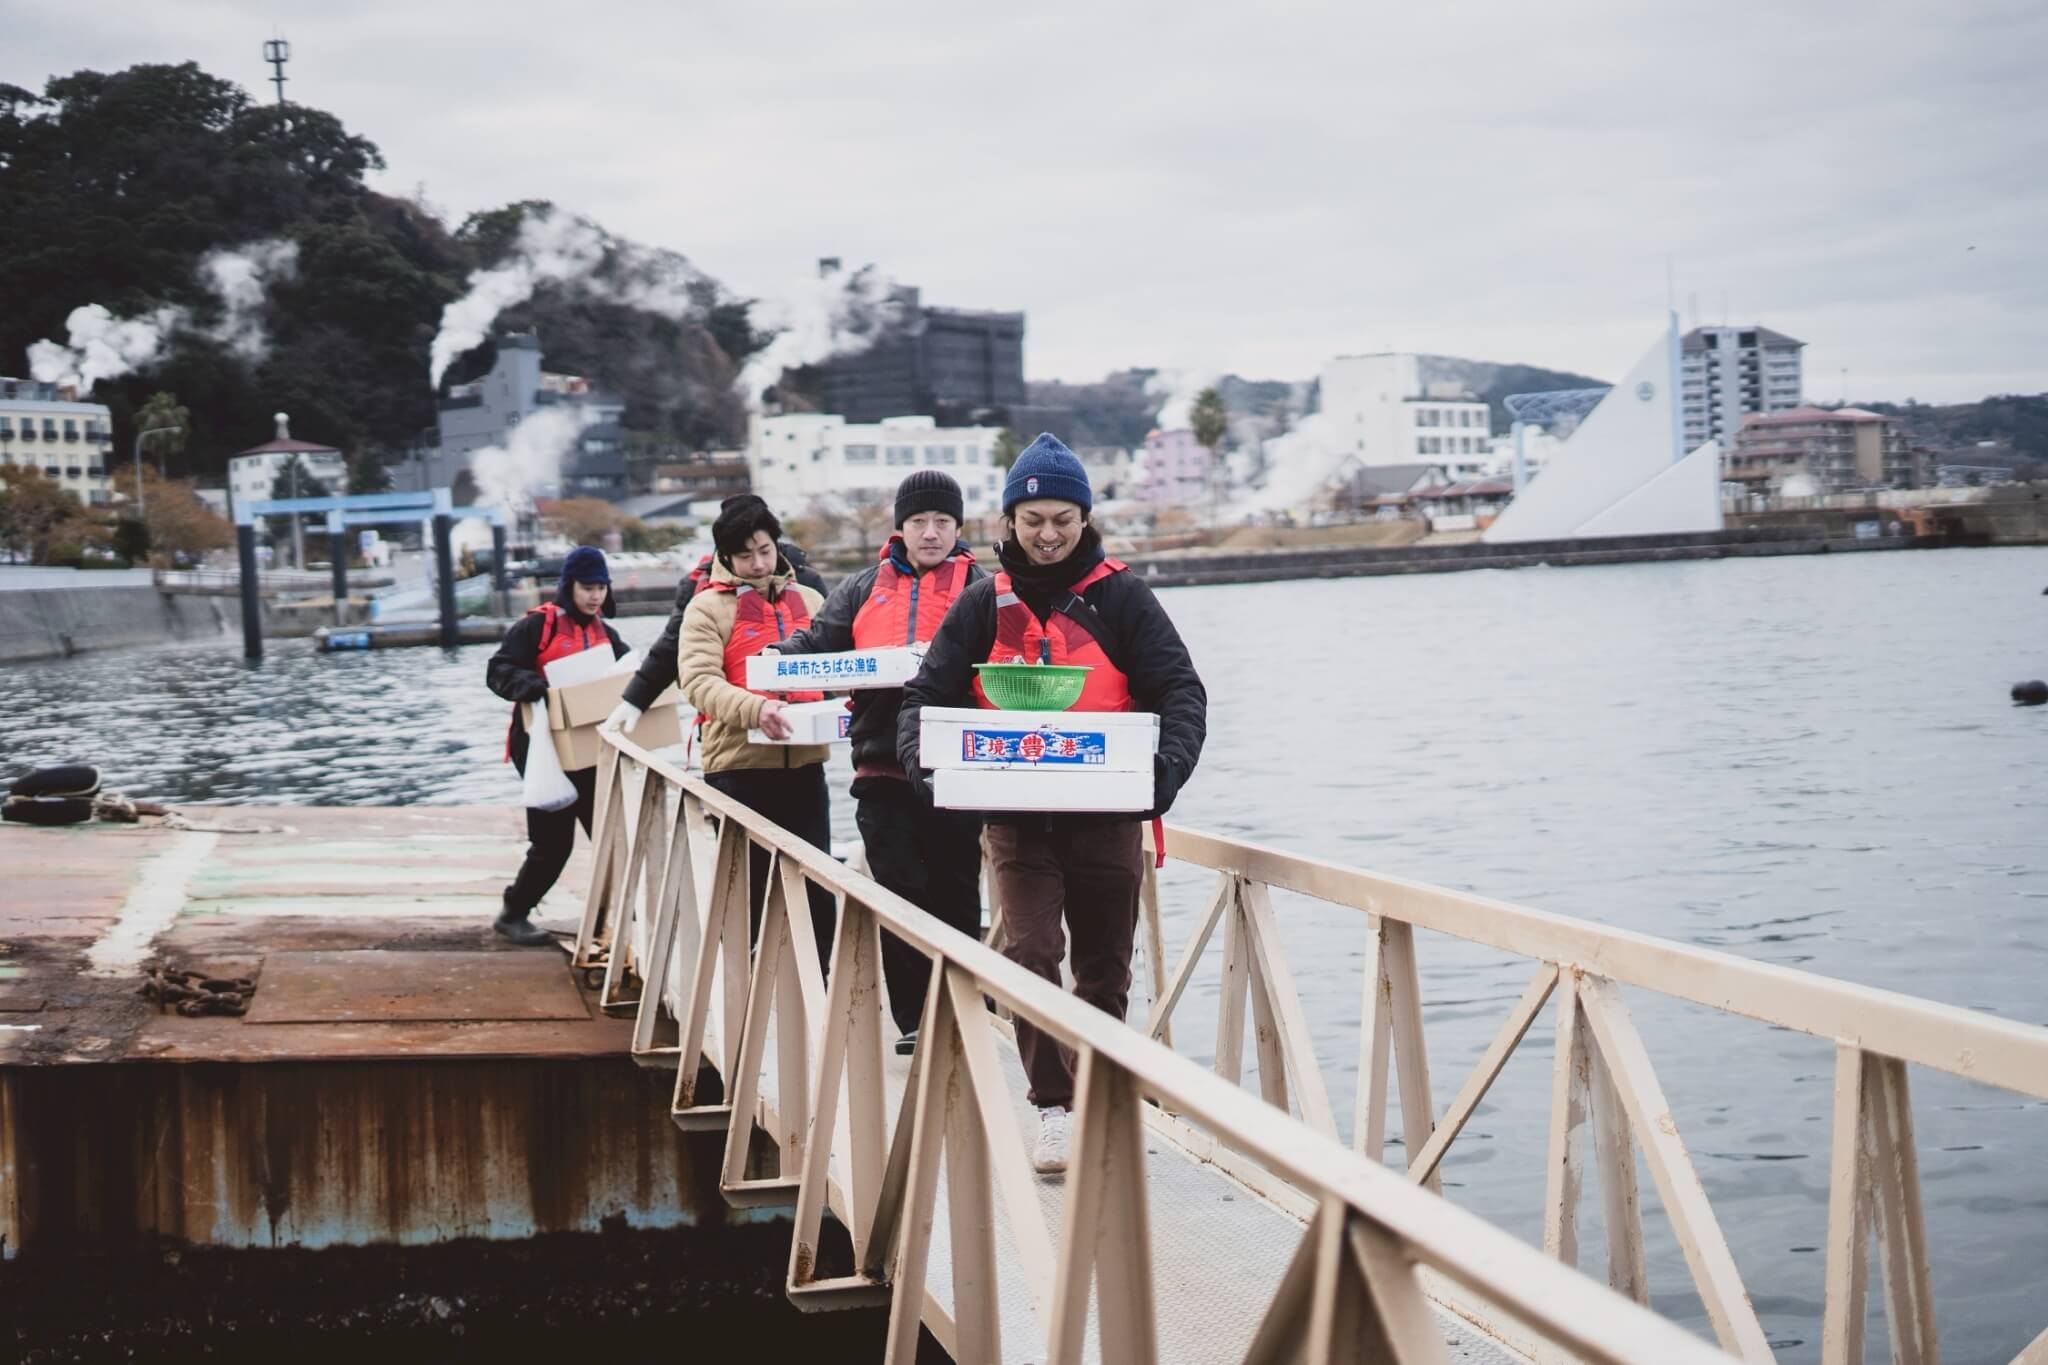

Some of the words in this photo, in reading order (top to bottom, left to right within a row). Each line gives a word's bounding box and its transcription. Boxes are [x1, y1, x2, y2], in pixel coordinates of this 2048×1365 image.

[777, 657, 877, 676] 長崎市たちばな漁協
